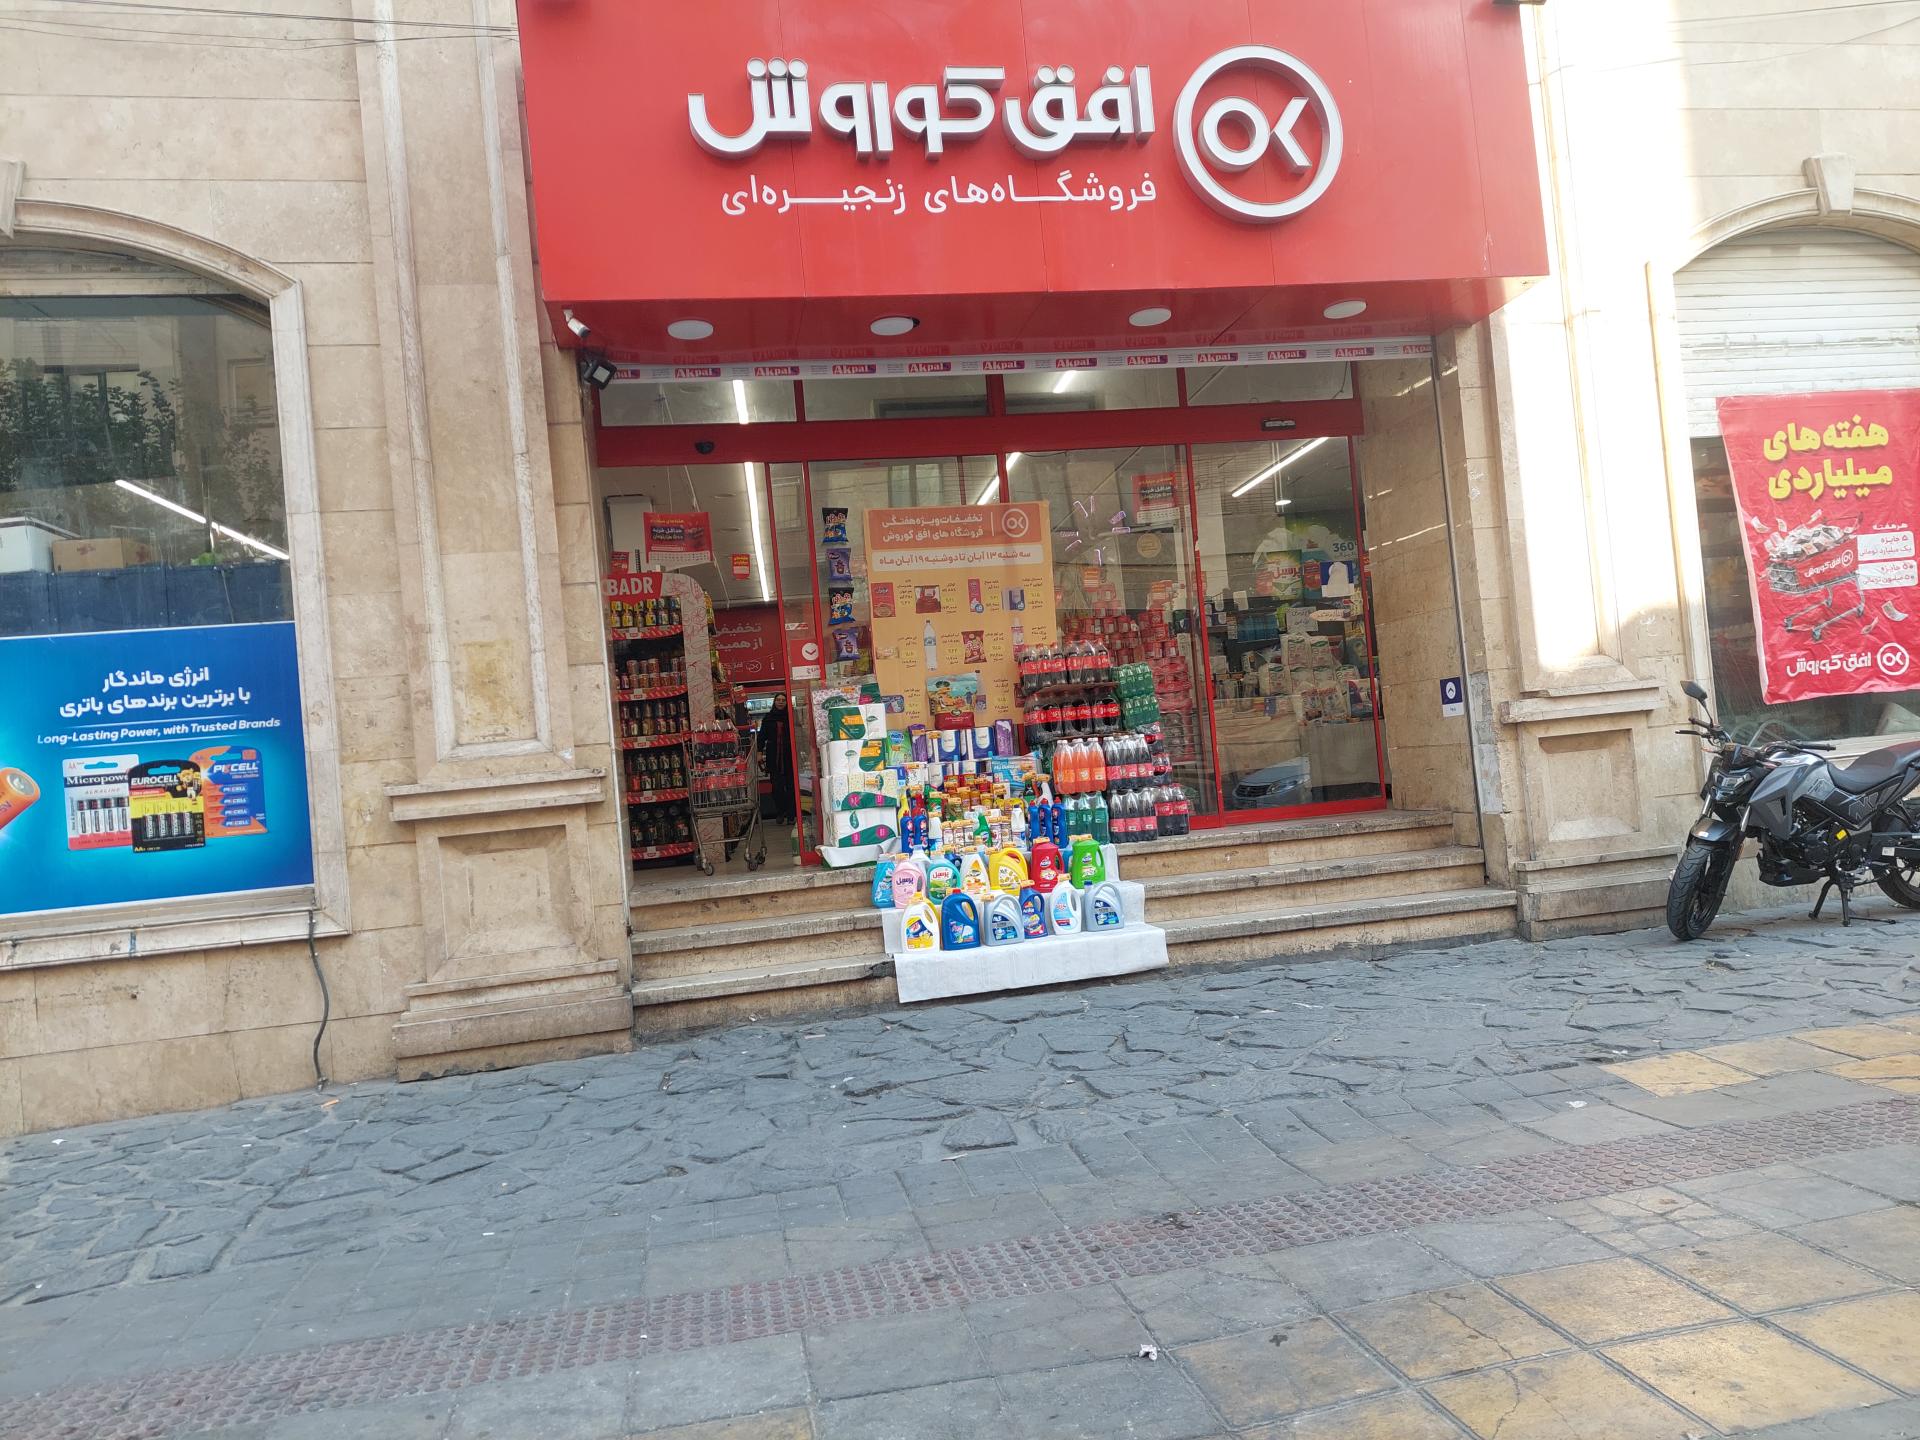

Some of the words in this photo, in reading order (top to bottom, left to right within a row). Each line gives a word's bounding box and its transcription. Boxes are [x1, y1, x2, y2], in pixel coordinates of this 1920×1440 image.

[688, 57, 1005, 161] کوروش
[1005, 65, 1155, 160] افق
[1128, 355, 1162, 366] Akpal
[1198, 352, 1232, 364] Akpal
[1268, 350, 1302, 361] Akpal
[1335, 347, 1369, 358] Akpal
[833, 364, 869, 374] Akpal
[909, 362, 945, 372] Akpal
[982, 360, 1017, 370] Akpal
[1056, 357, 1091, 368] Akpal
[676, 367, 714, 378] Akpal
[755, 366, 791, 377] Akpal
[1768, 458, 1893, 500] میلیاردی
[882, 530, 914, 543] کوروش
[916, 530, 931, 541] افق
[607, 577, 654, 596] BADR
[1786, 654, 1844, 677] کوروش
[1843, 652, 1872, 672] افق
[102, 669, 165, 693] ماندگار
[169, 666, 209, 688] انرژی
[107, 692, 177, 715] برندهای
[181, 688, 235, 708] برترین
[238, 686, 251, 705] با
[59, 696, 103, 719] باتری
[37, 728, 119, 746] Long-Lasting
[120, 726, 161, 739] Power,
[163, 724, 189, 735] with
[191, 721, 237, 733] Trusted
[238, 717, 281, 730] Brands
[131, 775, 179, 786] EUROCELL
